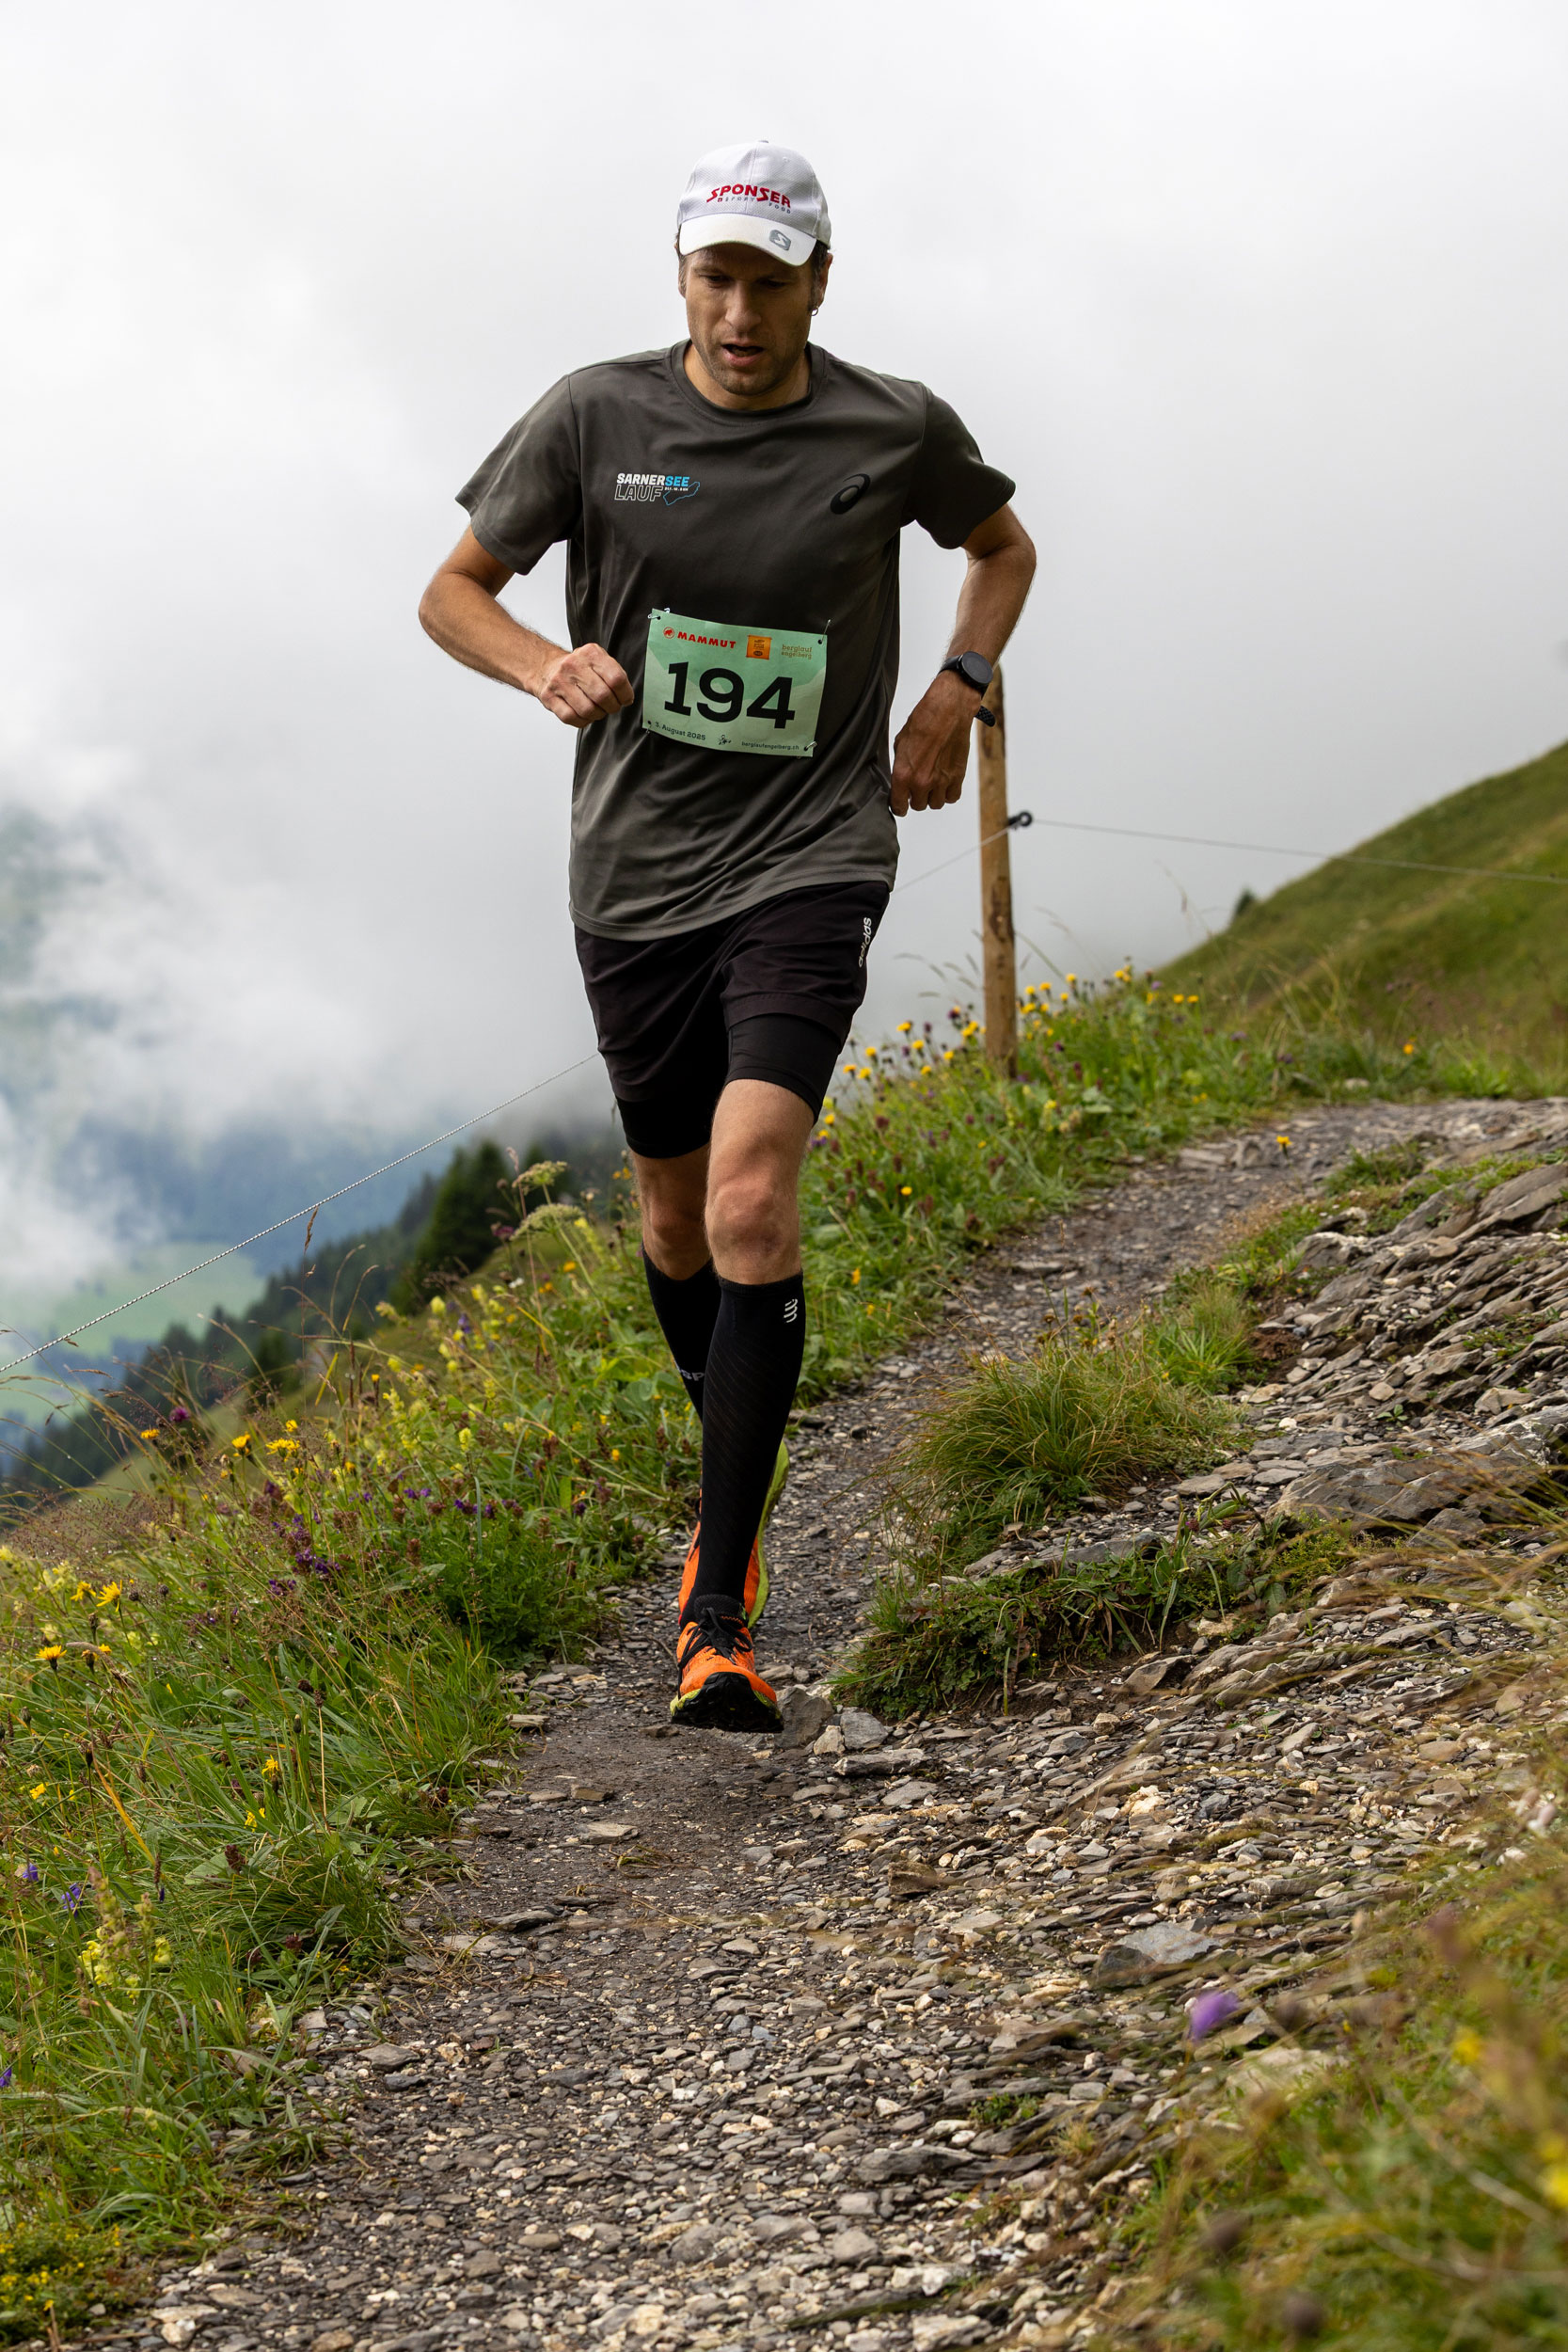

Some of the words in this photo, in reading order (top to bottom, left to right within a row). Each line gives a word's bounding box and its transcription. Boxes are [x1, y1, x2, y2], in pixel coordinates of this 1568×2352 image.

[706, 183, 791, 208] SPONSER
[614, 484, 664, 502] LAUF
[677, 631, 736, 649] MAMMUT
[782, 644, 813, 653] berglauf
[664, 661, 796, 729] 194
[661, 724, 686, 737] August
[687, 731, 706, 740] 2025
[858, 917, 872, 967] adidas
